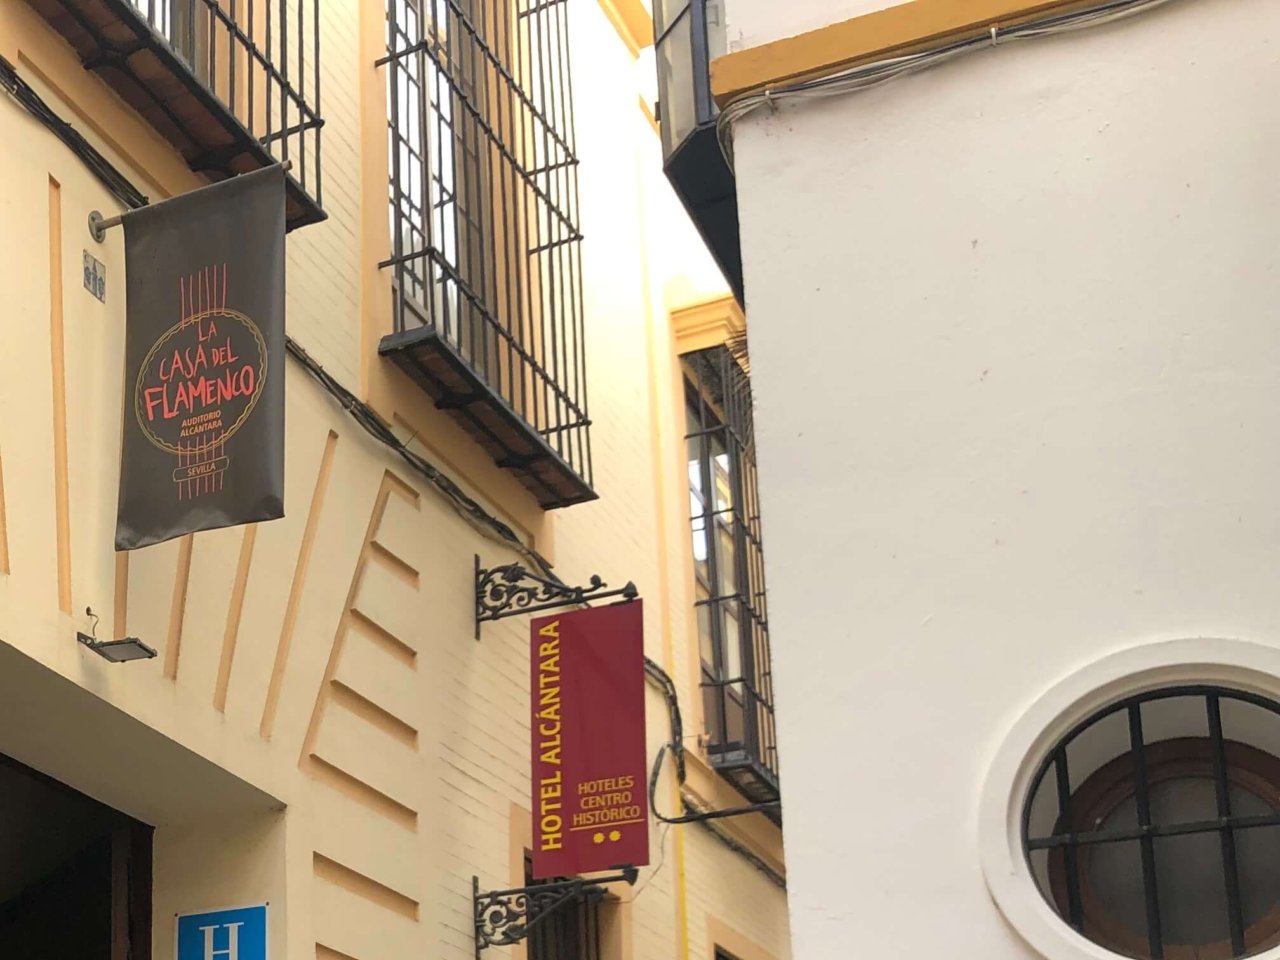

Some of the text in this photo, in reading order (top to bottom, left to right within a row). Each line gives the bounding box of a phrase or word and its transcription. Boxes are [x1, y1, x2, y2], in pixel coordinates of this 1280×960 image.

[198, 320, 217, 343] LA
[159, 336, 239, 382] CASA DEL
[144, 364, 255, 422] FLAMENCO
[181, 409, 222, 428] AUDITORIO
[187, 463, 217, 477] SEVILLA
[535, 619, 562, 851] HOTEL ALCÁNTARA
[577, 775, 635, 795] HOTELES
[580, 791, 632, 810] CENTRO
[573, 805, 641, 826] HISTÓRICO
